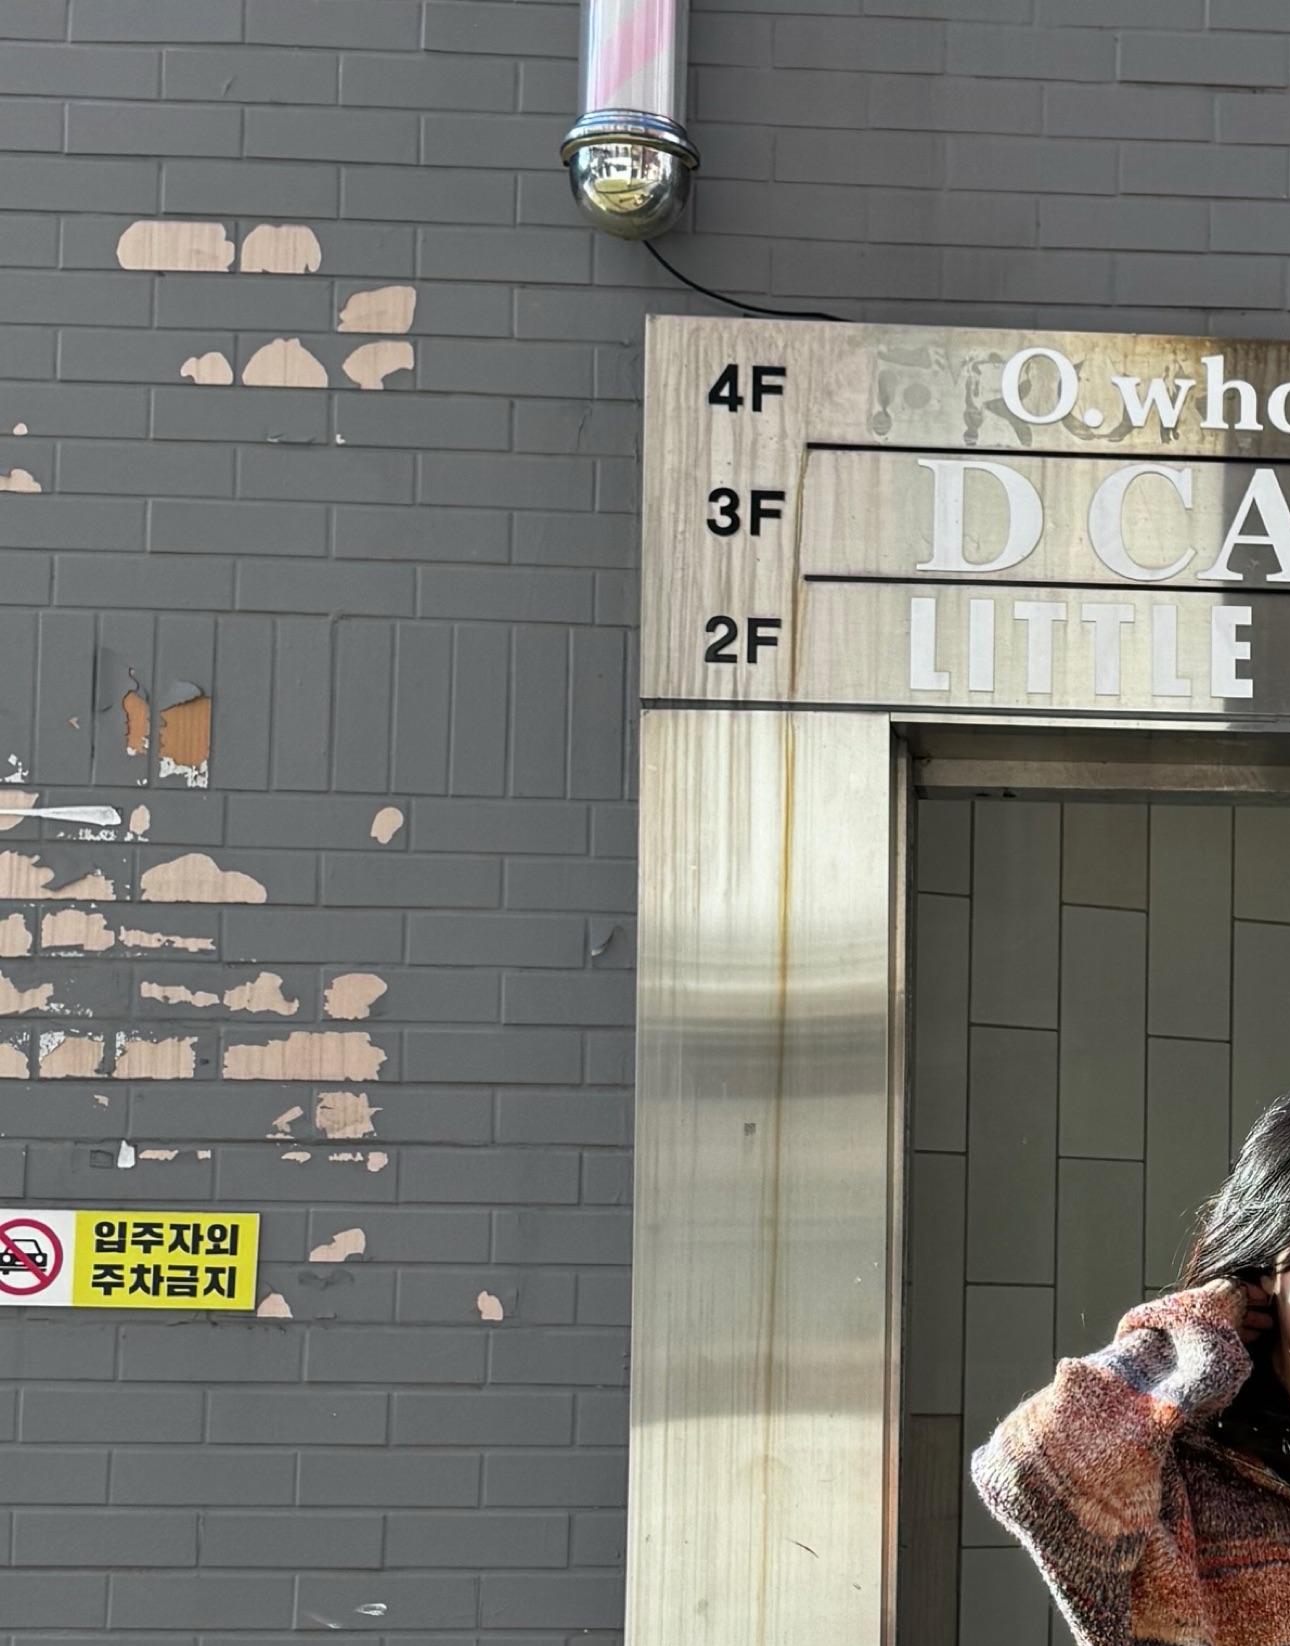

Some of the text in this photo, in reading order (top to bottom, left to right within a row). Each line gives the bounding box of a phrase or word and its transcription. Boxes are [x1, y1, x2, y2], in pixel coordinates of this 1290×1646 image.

[708, 364, 787, 413] 4F
[706, 487, 786, 536] 3F
[704, 615, 782, 664] 2F
[909, 597, 1254, 699] LITTLE
[94, 1221, 240, 1256] 입주자외
[91, 1263, 236, 1299] 주차금지
